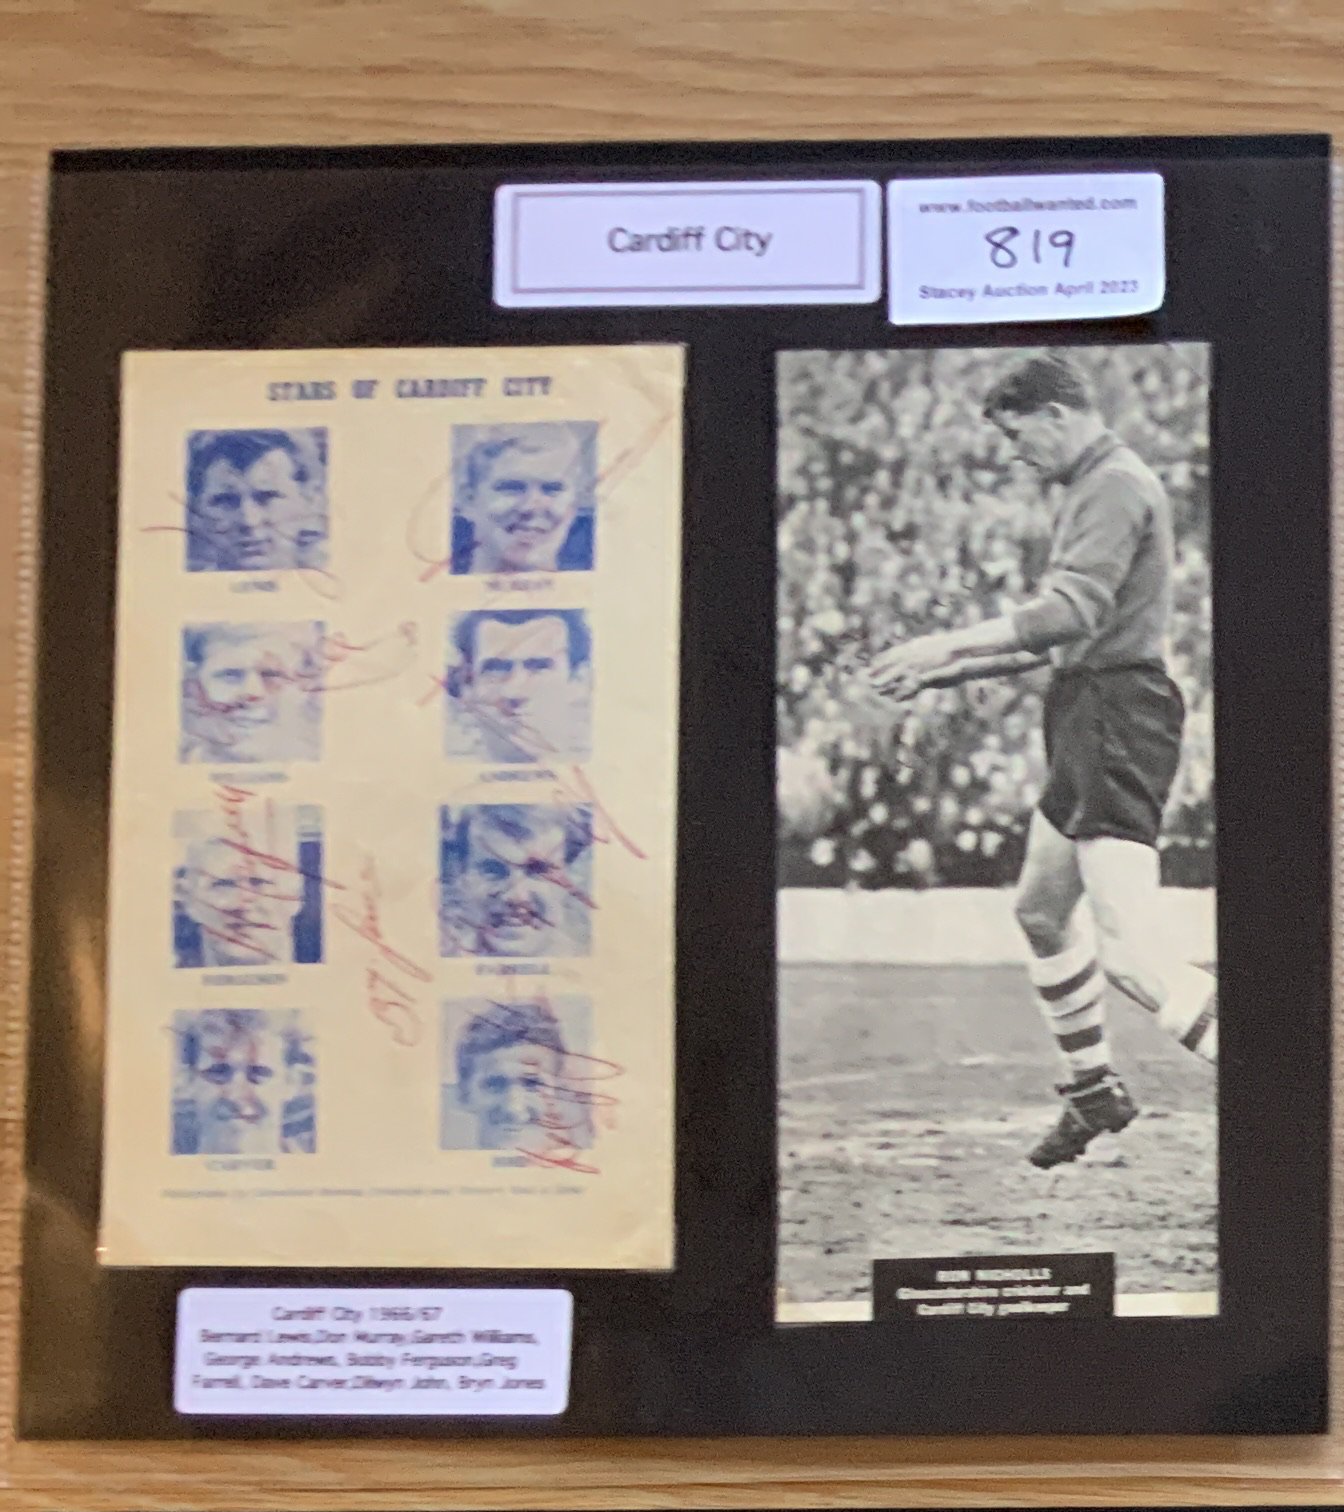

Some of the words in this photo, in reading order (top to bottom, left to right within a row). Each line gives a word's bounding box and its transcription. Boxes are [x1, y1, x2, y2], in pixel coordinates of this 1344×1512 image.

[607, 224, 704, 254] Cardiff
[713, 224, 774, 257] City
[984, 226, 1076, 269] 819
[919, 285, 976, 300] Stacey
[983, 283, 1049, 298] Auction
[1055, 281, 1094, 298] April
[1100, 279, 1139, 294] 2023
[267, 380, 338, 401] STARS
[351, 378, 379, 400] OF
[395, 376, 488, 399] CARDIFF
[503, 375, 553, 397] CITY
[271, 1306, 327, 1322] Cardiff
[331, 1306, 364, 1324] City
[199, 1328, 262, 1344] Bernard
[203, 1351, 260, 1369] George
[346, 1351, 396, 1370] Bobby
[251, 1374, 291, 1389] Dave
[458, 1374, 496, 1393] Bryn
[499, 1374, 547, 1390] Jones
